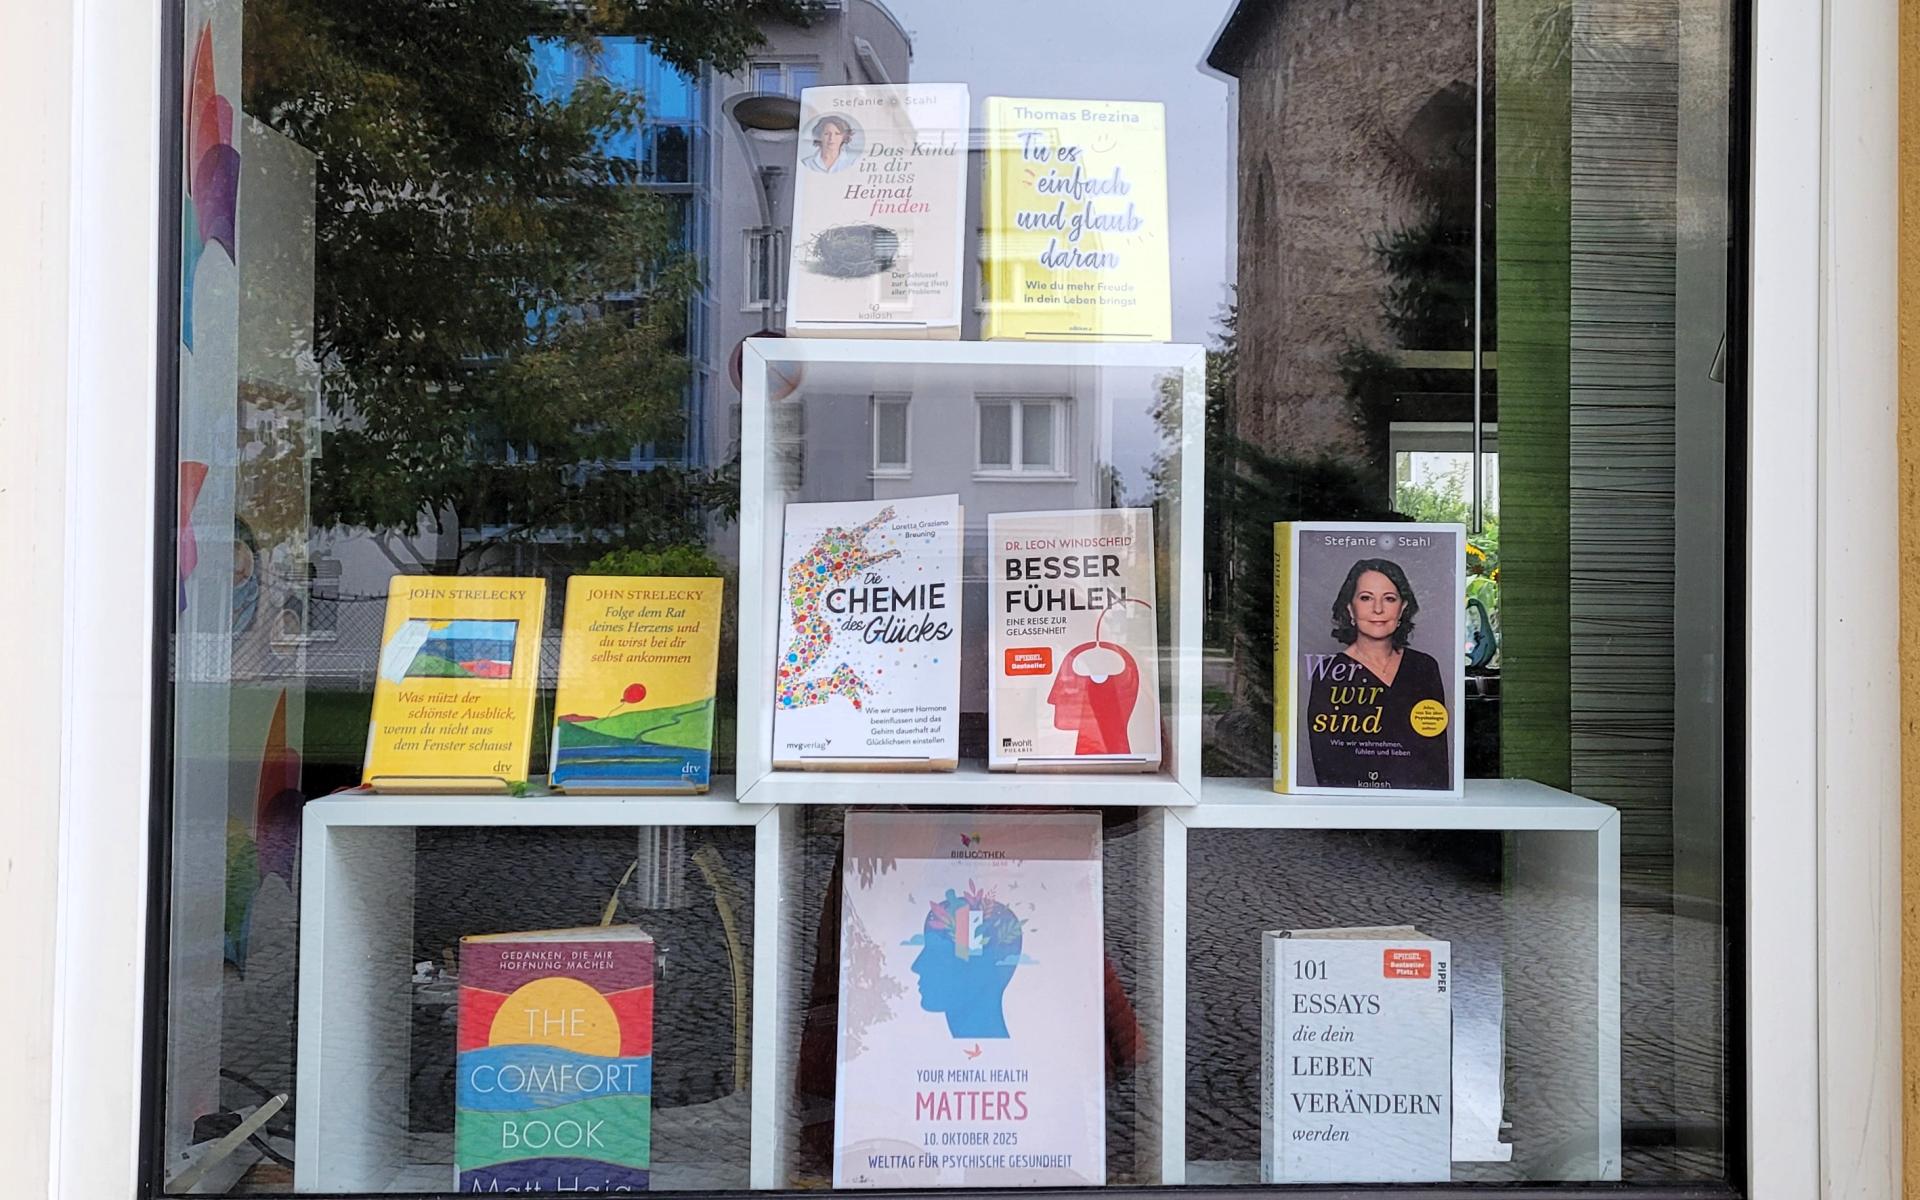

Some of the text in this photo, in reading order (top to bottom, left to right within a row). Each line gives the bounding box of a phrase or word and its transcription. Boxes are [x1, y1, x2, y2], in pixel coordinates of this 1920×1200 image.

[832, 96, 937, 107] Stefanie Stahl
[1014, 107, 1140, 123] Thomas Brezina
[869, 142, 957, 158] Das Kind
[1018, 132, 1082, 162] Tu es
[859, 158, 912, 172] in dir
[867, 173, 915, 184] muss
[1038, 166, 1131, 201] einfach
[844, 185, 913, 200] Heimat
[870, 200, 930, 217] finden
[1018, 201, 1143, 242] und glaub
[1040, 239, 1119, 269] daran
[1026, 280, 1135, 292] Wie du mehr Freude
[1037, 294, 1060, 304] dein
[1064, 295, 1096, 305] Leben
[1100, 296, 1137, 308] bringst
[892, 520, 948, 531] Loretta Graziano
[905, 530, 936, 539] Breuning
[1006, 536, 1132, 550] DR. LEON WINDSCHEID
[1324, 536, 1431, 548] Stefanie Stahl
[1006, 554, 1120, 580] BESSER
[864, 572, 882, 585] Die
[408, 589, 527, 600] JOHN STRELECKY
[586, 590, 704, 601] JOHN STRELECKY
[826, 583, 946, 614] CHEMIE
[1006, 584, 1126, 613] FÜHLEN
[605, 606, 686, 620] Folge dem Rat
[588, 621, 700, 633] deines Herzens und
[841, 612, 953, 644] des Glücks
[1006, 616, 1067, 626] EINE REISE ZUR
[1006, 627, 1066, 636] GELASSENHEIT
[600, 636, 686, 648] du wirst bei dir
[592, 652, 691, 663] selbst ankommen
[1304, 654, 1364, 682] Wer
[398, 692, 480, 704] Was nützt der
[1330, 678, 1384, 705] wir
[408, 706, 516, 721] schönste Ausblick,
[1313, 705, 1384, 734] sind
[384, 723, 493, 735] wenn du nicht aus
[896, 726, 928, 734] dauerhaft
[394, 739, 512, 751] dem Fenster schaust
[866, 738, 911, 746] Glücklichsein
[493, 761, 512, 772] dtv
[682, 762, 700, 774] dtv
[1358, 780, 1391, 789] kailash
[502, 951, 613, 960] GEDANKEN, DIE MIR
[500, 961, 614, 970] HOFFNUNG MACHEN
[1294, 960, 1328, 980] 101
[1438, 962, 1446, 992] PIPER
[1292, 994, 1380, 1014] ESSAYS
[524, 1009, 585, 1037] THE
[1292, 1025, 1354, 1042] die dein
[1292, 1056, 1374, 1077] LEBEN
[471, 1064, 638, 1093] COMFORT
[917, 1069, 1028, 1084] YOUR MENTAL HEALTH
[916, 1091, 1028, 1120] MATTERS
[1291, 1090, 1442, 1115] VERÄNDERN
[502, 1120, 604, 1149] BOOK
[924, 1132, 1018, 1145] 10. OKTOBER 2025
[1292, 1124, 1350, 1142] werden
[868, 1152, 1072, 1168] WELTTAG FÜR PSYCHISCHE GESUNDHEIT
